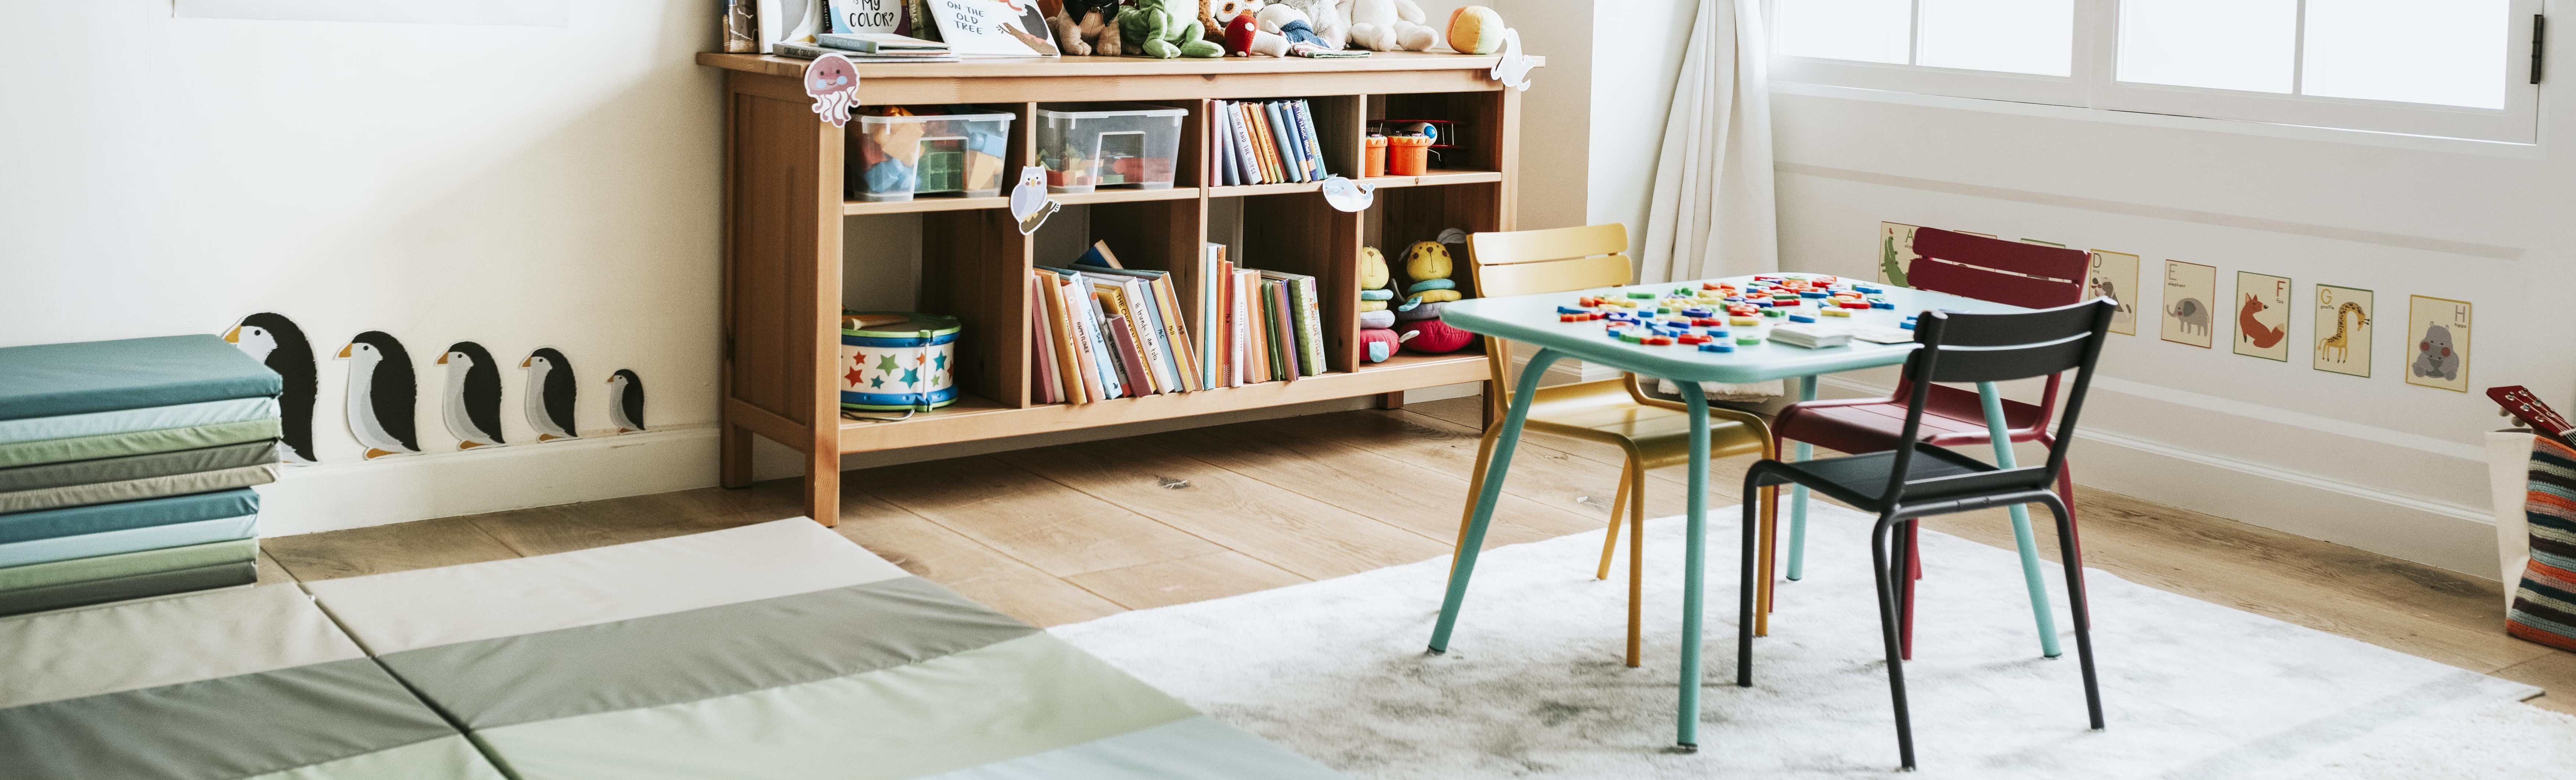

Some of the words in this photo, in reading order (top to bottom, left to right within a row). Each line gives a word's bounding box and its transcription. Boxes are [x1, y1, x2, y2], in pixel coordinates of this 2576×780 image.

[862, 0, 880, 11] MY
[947, 1, 961, 10] ON
[965, 6, 984, 17] THE
[850, 12, 894, 27] COLOR?
[956, 13, 978, 24] OLD
[953, 20, 983, 35] TREE
[1299, 121, 1307, 139] MAGIC
[1233, 112, 1242, 129] JENNY
[1247, 157, 1257, 176] HORSE
[1905, 228, 1914, 243] A
[2093, 253, 2102, 268] D
[2169, 263, 2178, 280] E
[2277, 281, 2286, 297] F
[2321, 288, 2332, 305] G
[1087, 308, 1098, 333] Suspicious
[1116, 293, 1125, 308] THE
[1121, 308, 1136, 338] CHICKEN
[2455, 305, 2465, 323] H
[1080, 335, 1090, 354] FLOWER
[1147, 338, 1153, 347] am
